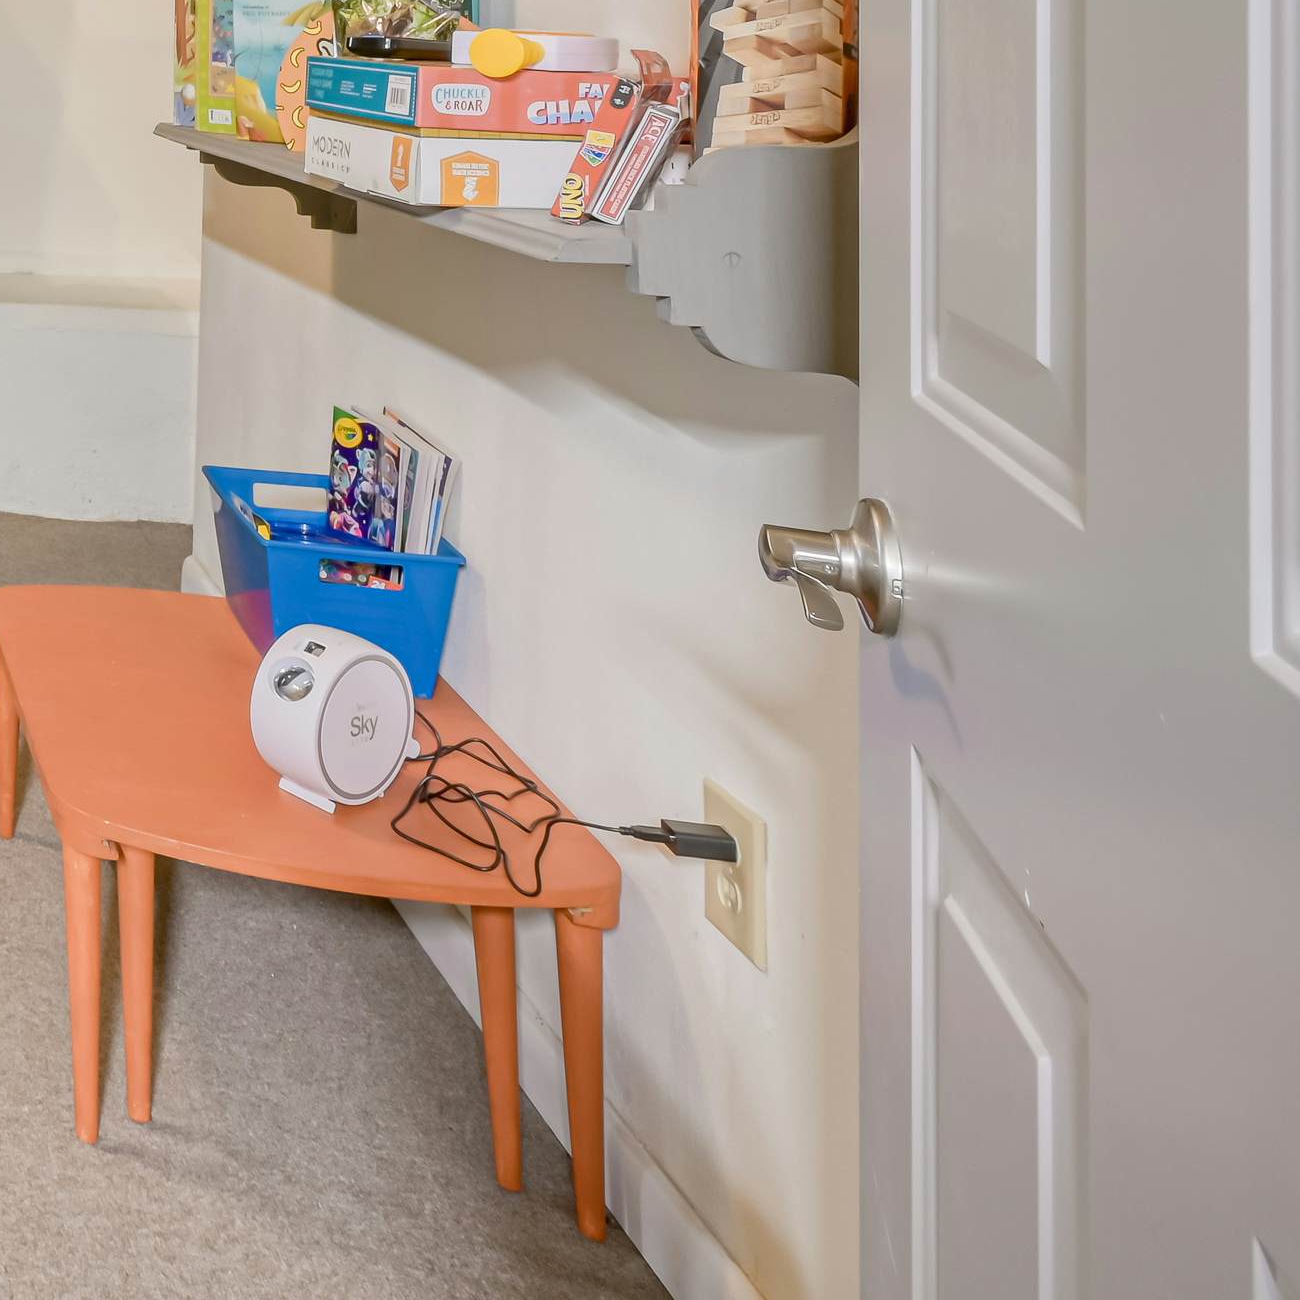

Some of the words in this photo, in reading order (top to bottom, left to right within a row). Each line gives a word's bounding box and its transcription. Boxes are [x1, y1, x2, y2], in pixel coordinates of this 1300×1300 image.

[435, 88, 486, 104] CHUCKLE
[453, 99, 483, 112] ROAR
[641, 115, 666, 143] ACE
[312, 135, 351, 158] MODERN
[560, 172, 584, 220] UNO
[350, 714, 379, 741] Sky
